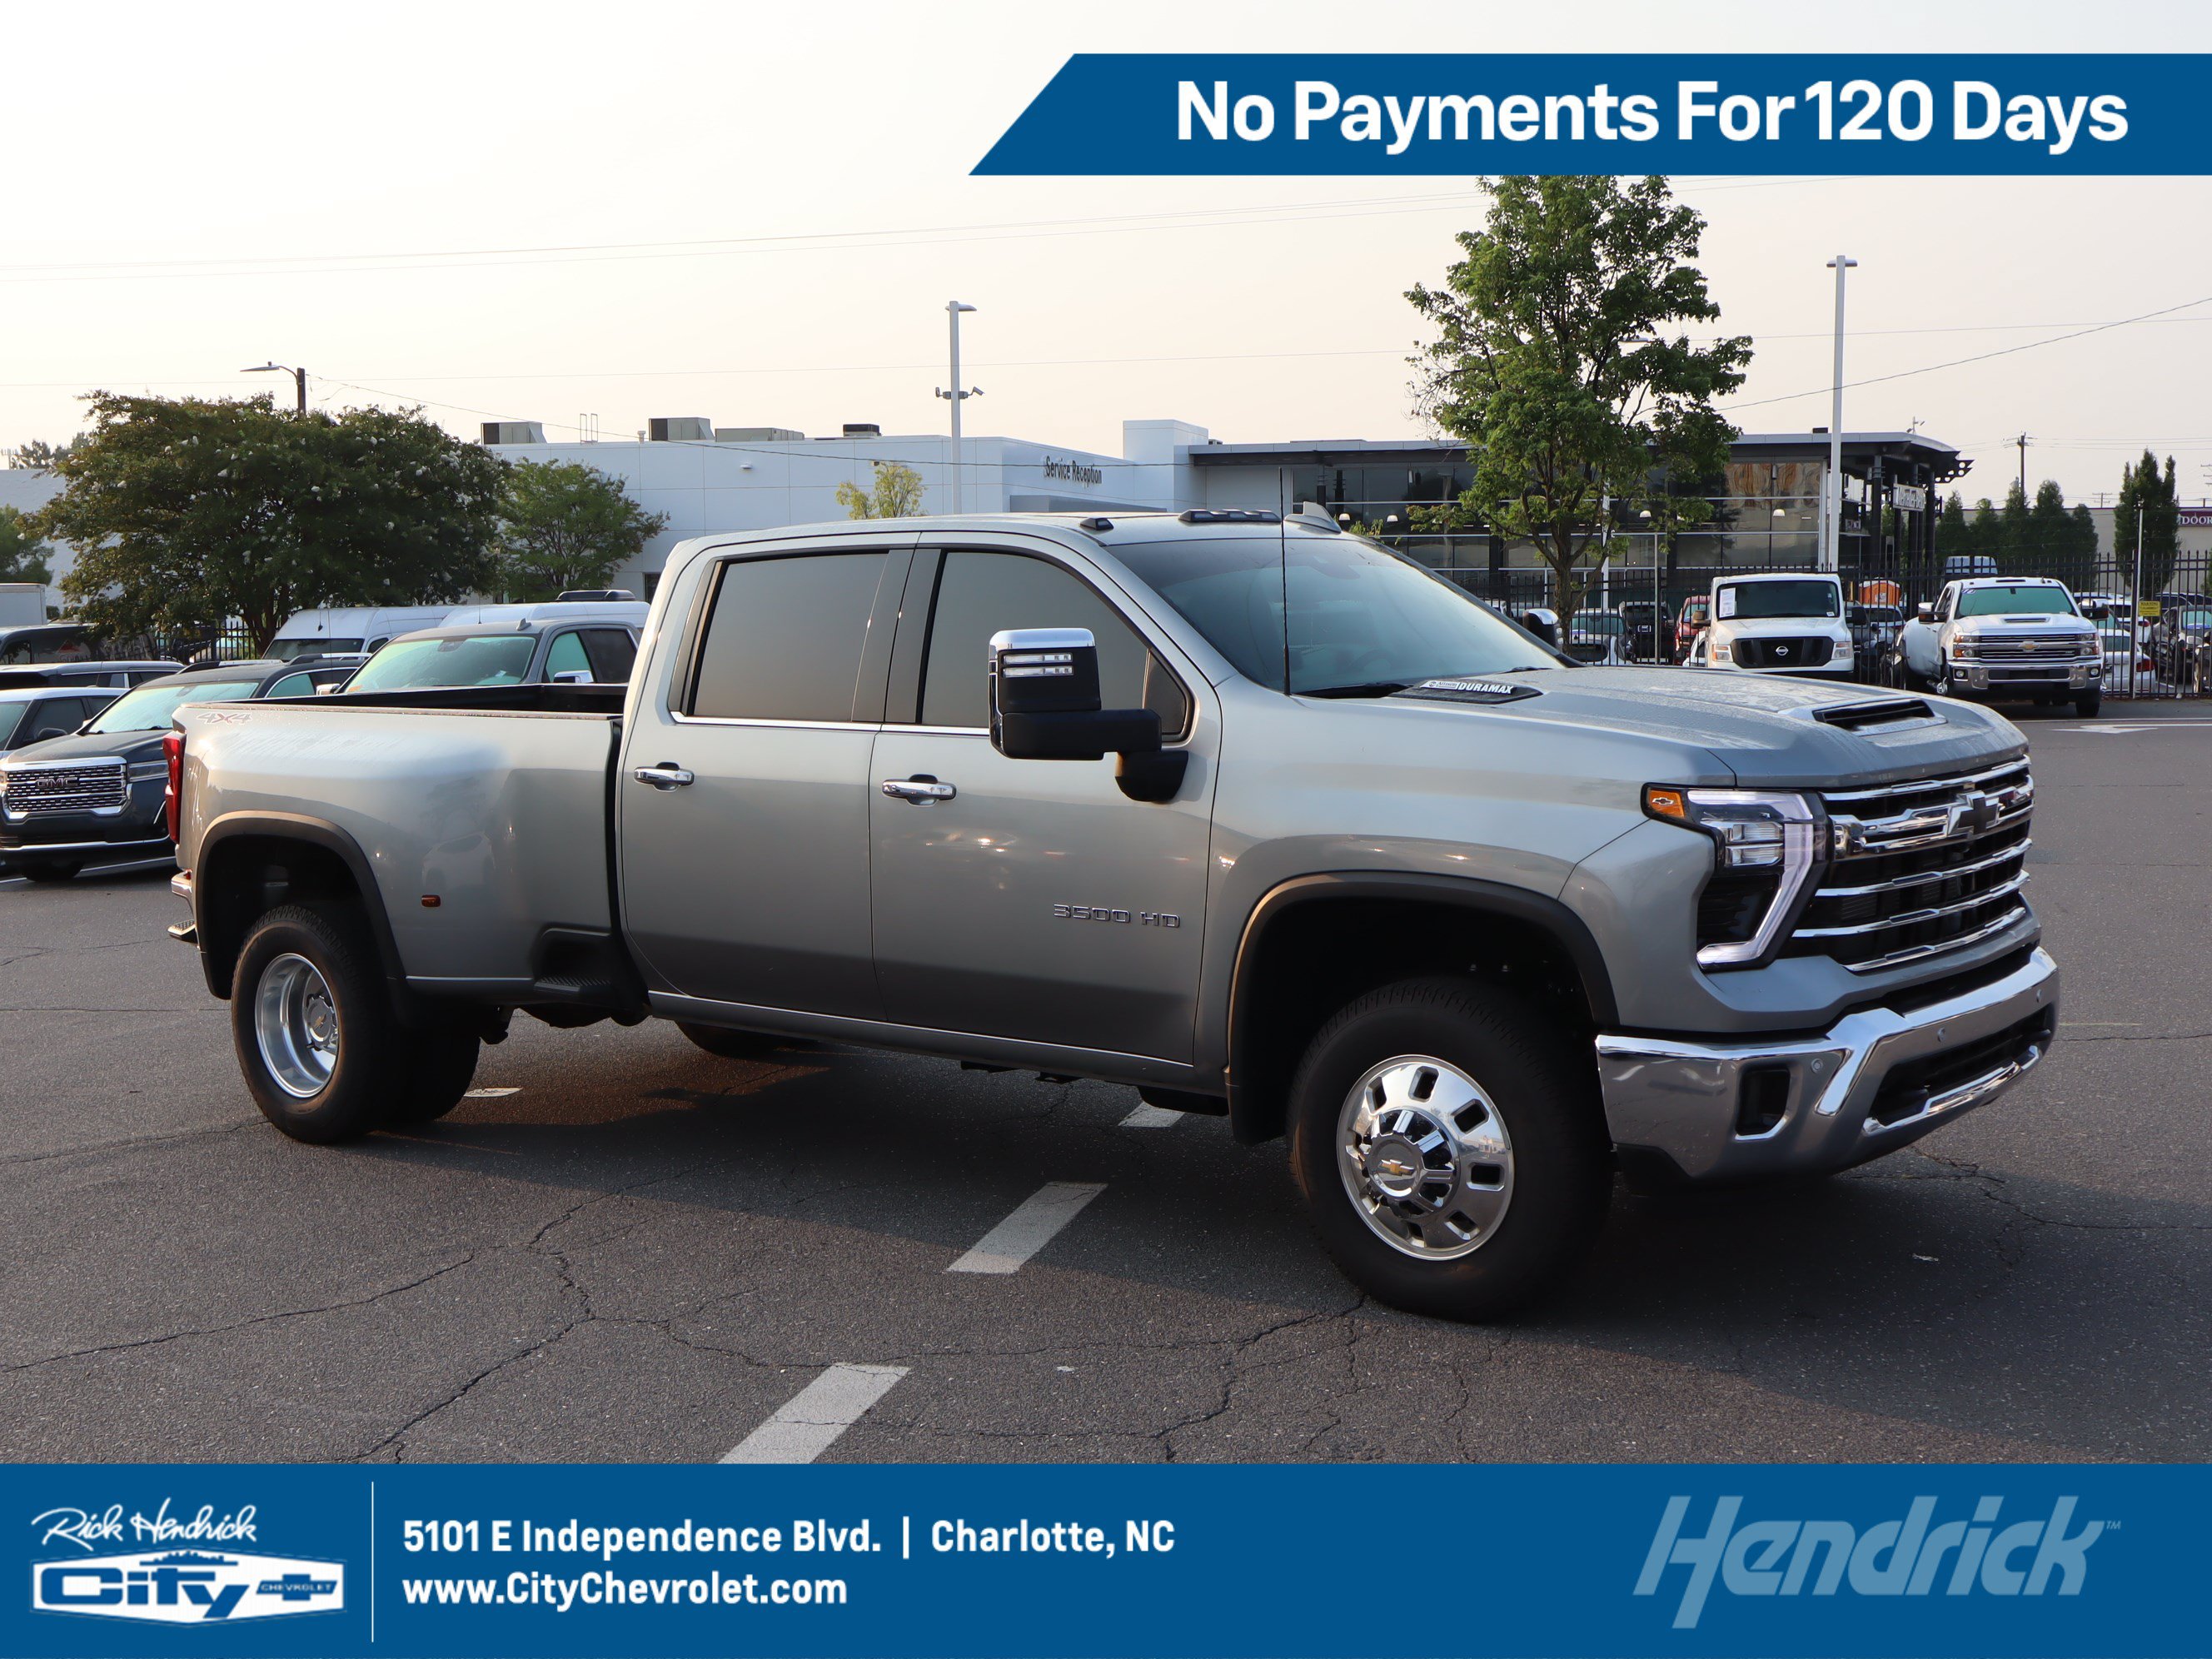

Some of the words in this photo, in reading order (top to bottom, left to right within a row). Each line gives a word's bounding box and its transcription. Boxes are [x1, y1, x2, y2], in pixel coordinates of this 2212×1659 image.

[1045, 455, 1071, 481] Service
[1072, 459, 1103, 488] Reception
[1457, 682, 1514, 694] DURAMAX
[37, 776, 79, 788] GMC
[1054, 904, 1131, 924] 3500
[1140, 911, 1181, 929] HD
